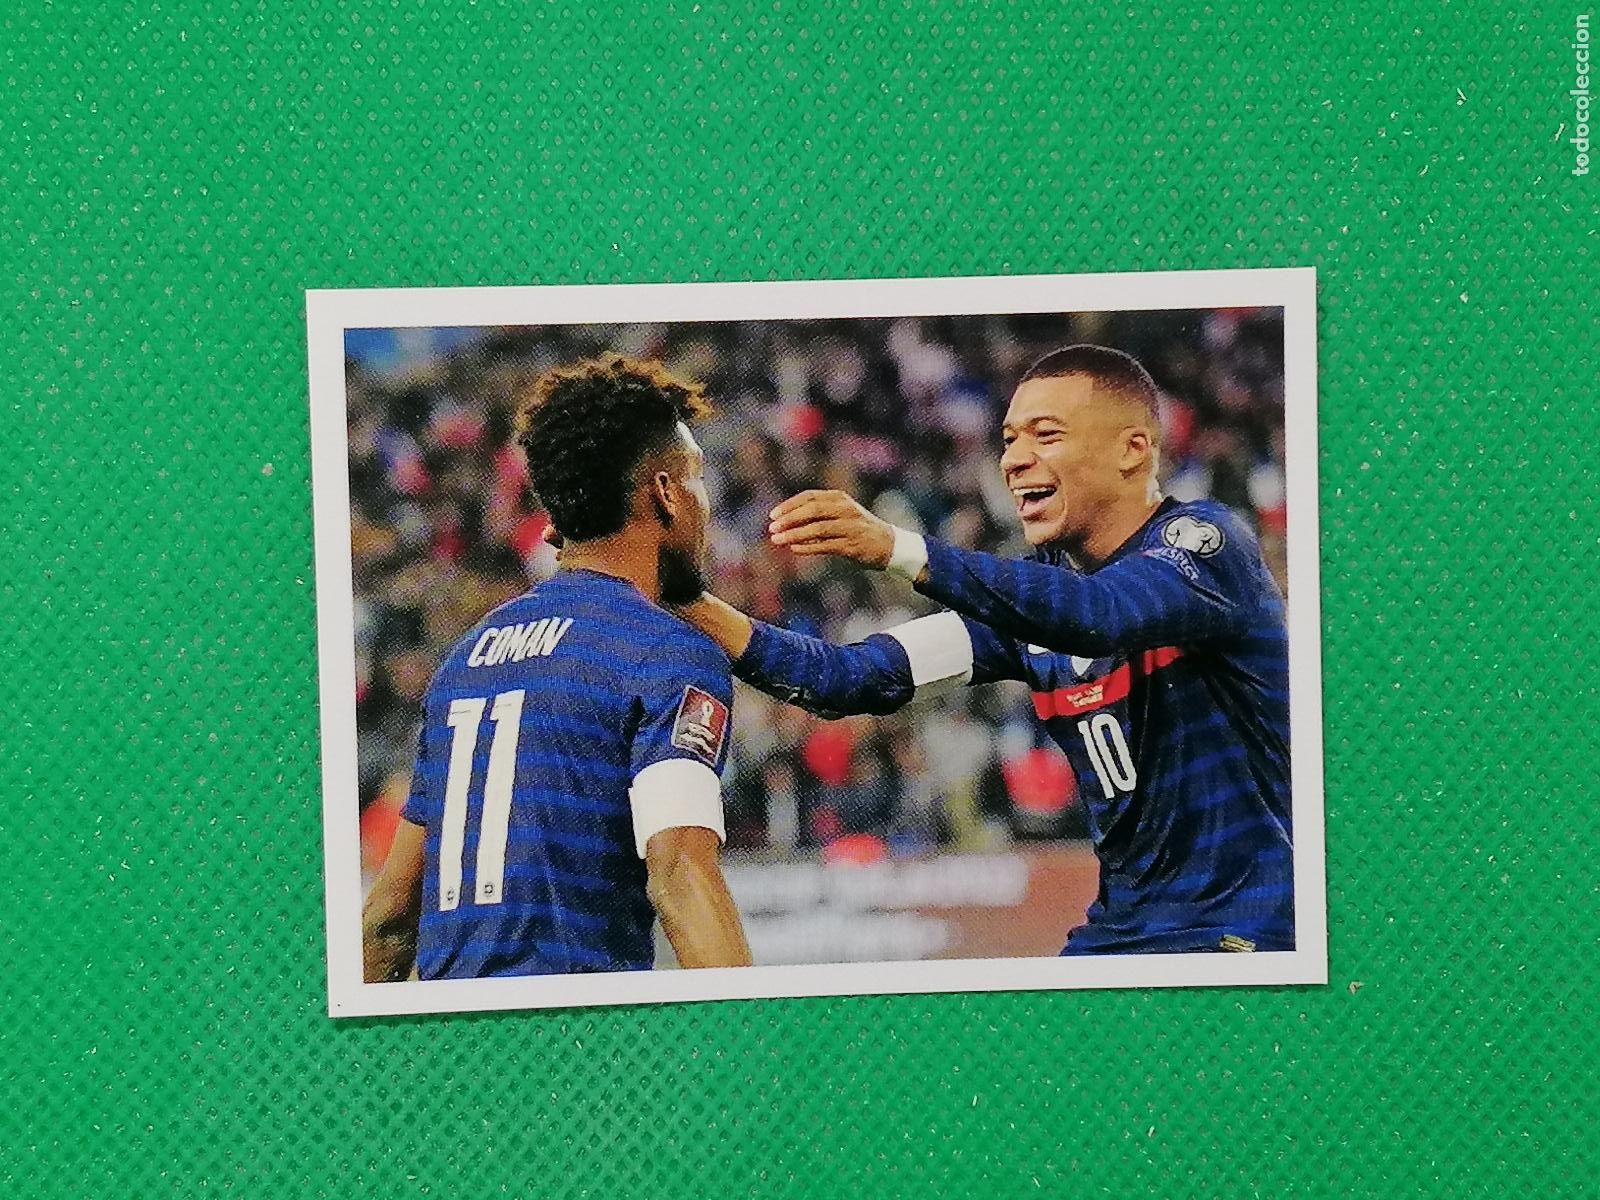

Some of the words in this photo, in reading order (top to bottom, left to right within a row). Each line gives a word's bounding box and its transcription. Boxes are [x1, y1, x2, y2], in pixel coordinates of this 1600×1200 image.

[467, 616, 574, 668] COMAN
[1077, 713, 1138, 800] 10
[438, 689, 526, 912] 11
